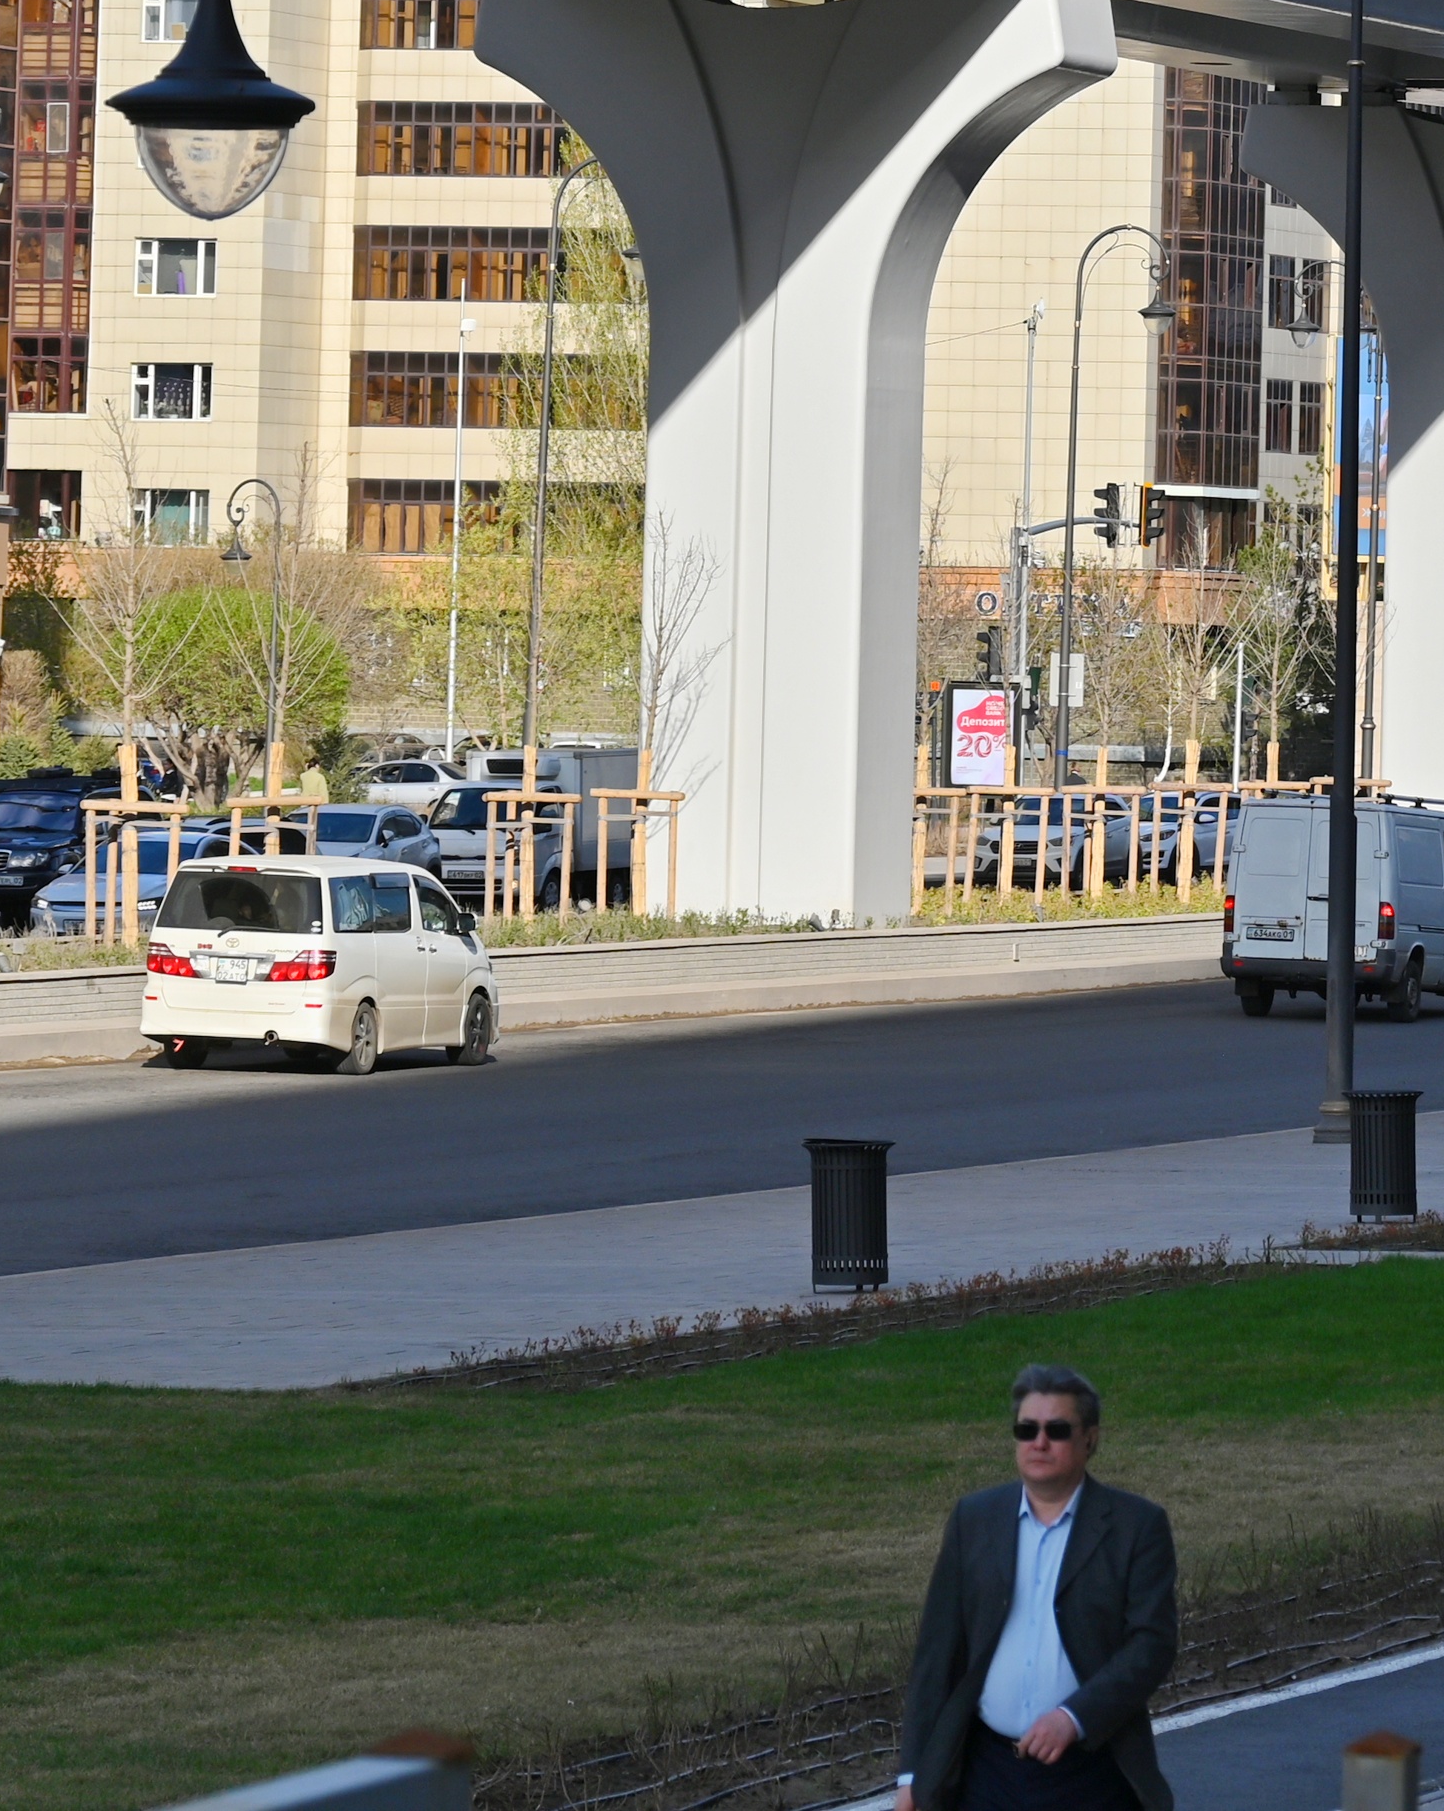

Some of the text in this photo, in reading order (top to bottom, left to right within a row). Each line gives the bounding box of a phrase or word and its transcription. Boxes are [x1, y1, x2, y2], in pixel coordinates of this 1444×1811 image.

[960, 716, 1005, 727] Депозит
[957, 734, 1008, 758] 20%
[229, 959, 247, 970] 945
